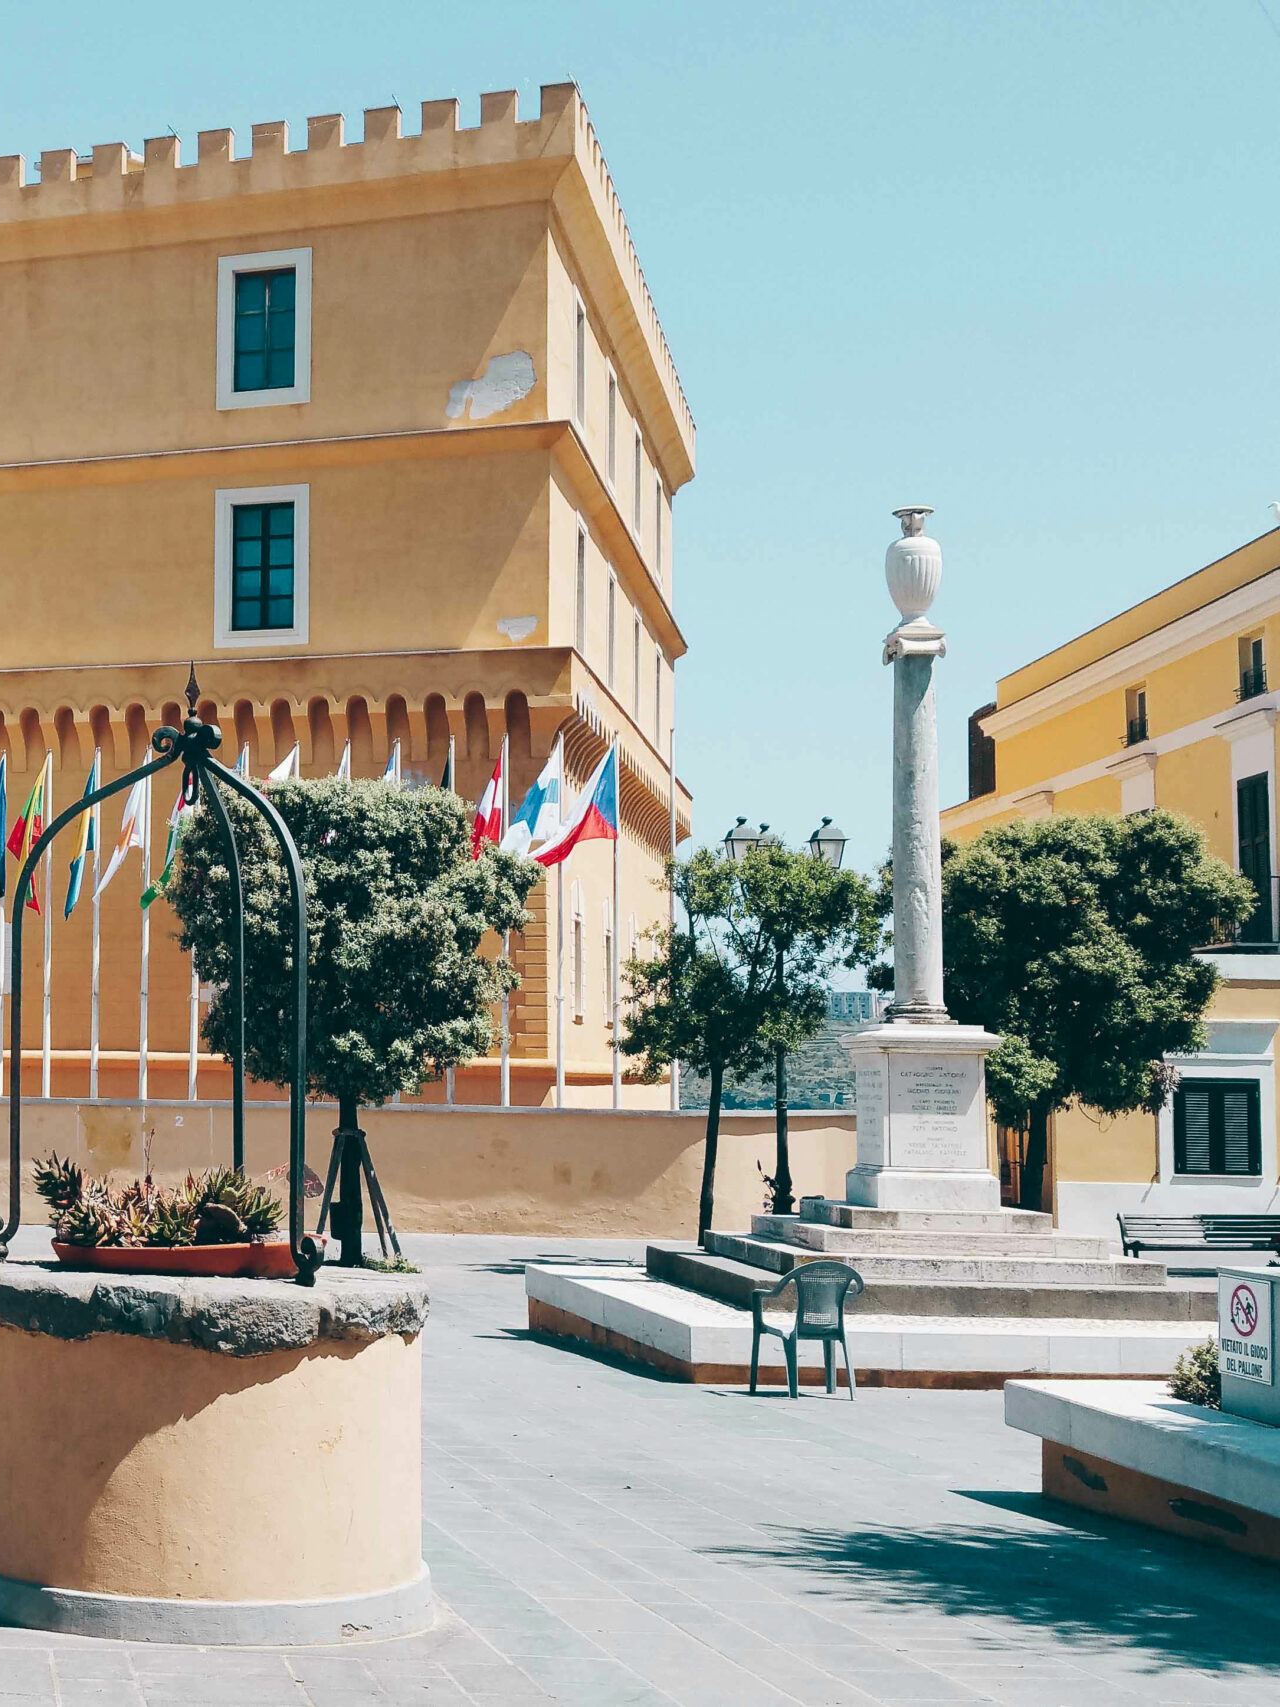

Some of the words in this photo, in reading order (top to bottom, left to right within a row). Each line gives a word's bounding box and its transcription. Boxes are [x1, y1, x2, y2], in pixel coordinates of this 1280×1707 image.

[175, 1115, 185, 1127] 2
[1221, 1338, 1243, 1354] VIETATO
[1244, 1342, 1249, 1356] IL
[1250, 1344, 1268, 1360] GIOCO
[1226, 1357, 1237, 1372] DEL
[1238, 1359, 1263, 1378] PALLONE
